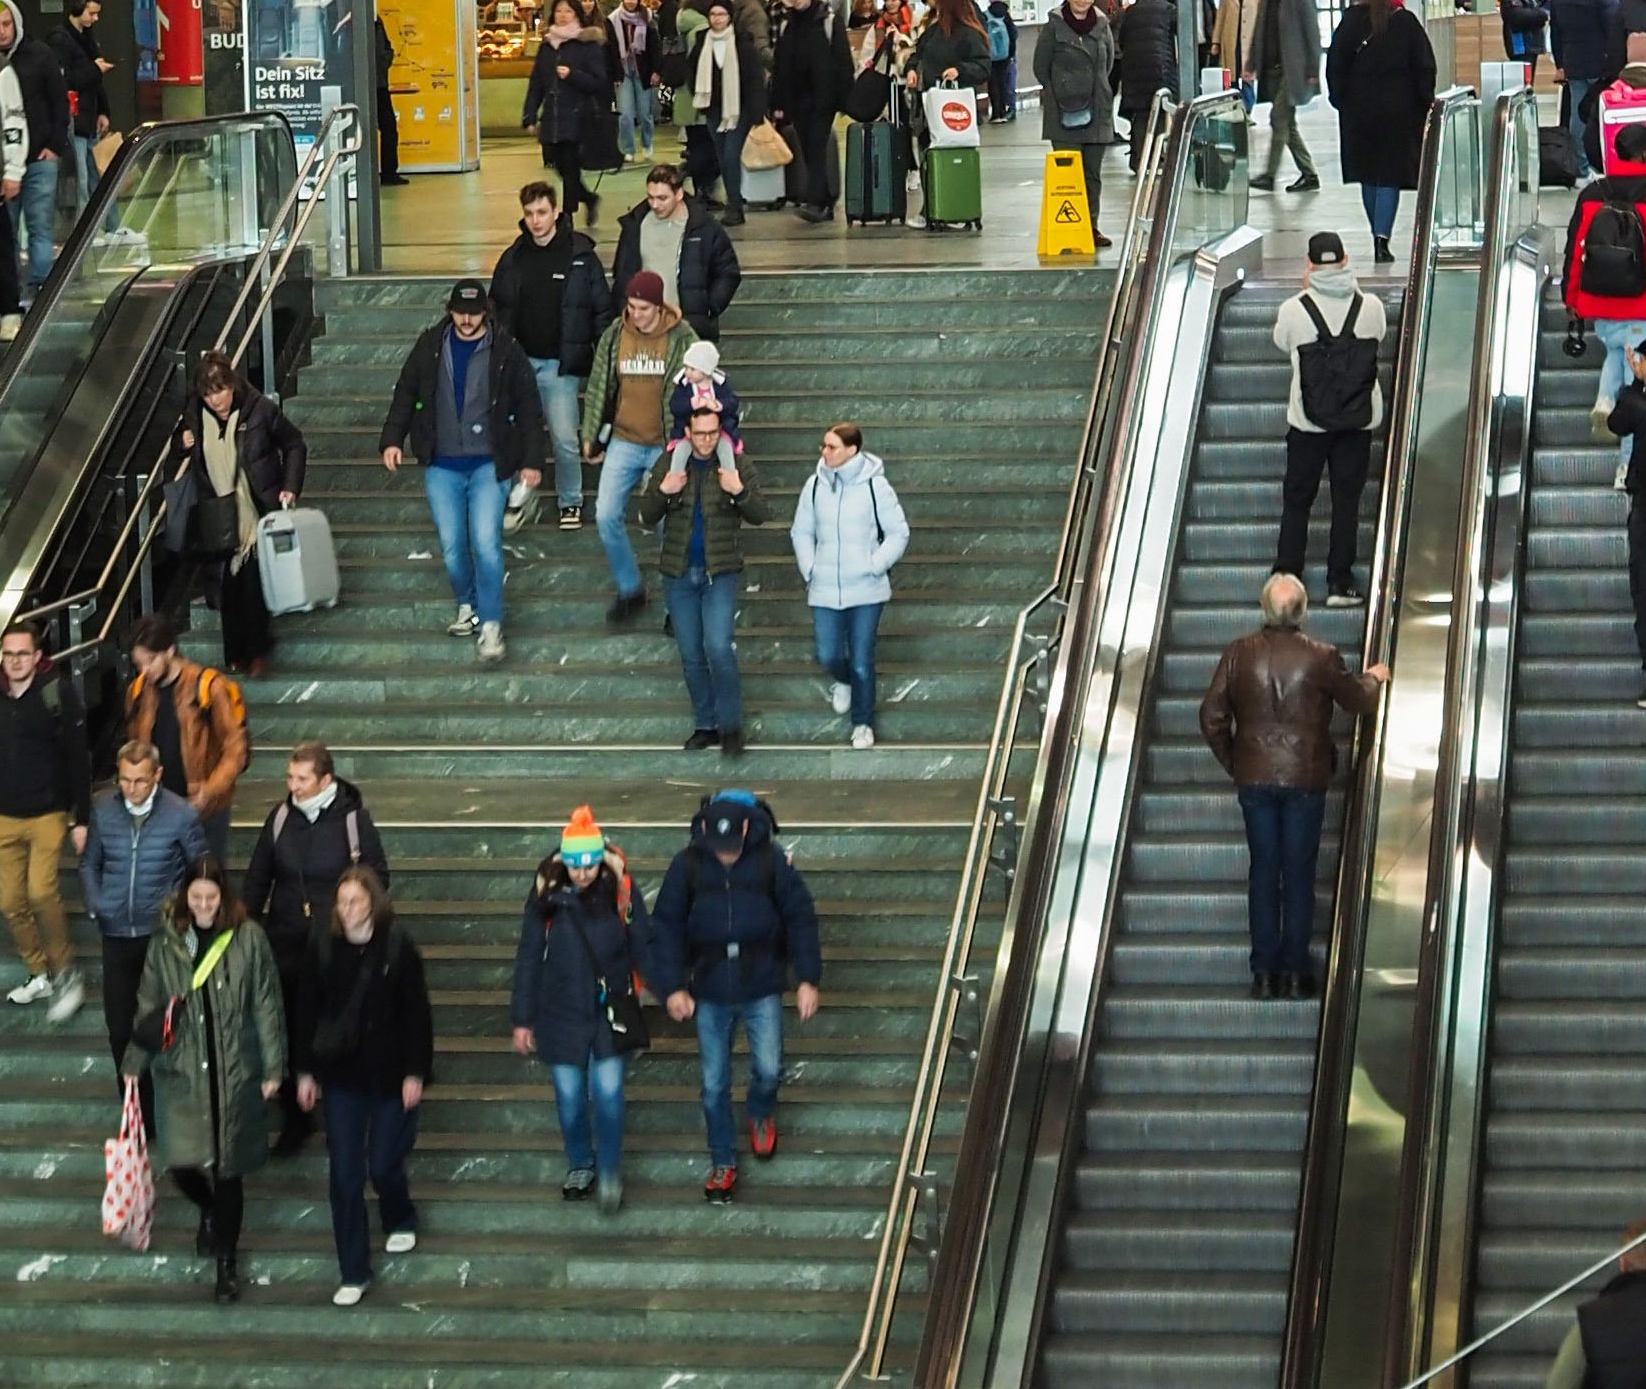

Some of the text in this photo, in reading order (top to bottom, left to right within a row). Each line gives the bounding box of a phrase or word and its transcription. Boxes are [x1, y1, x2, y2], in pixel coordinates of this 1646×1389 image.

[255, 65, 325, 81] Dein Sitz
[255, 83, 305, 99] ist fix!
